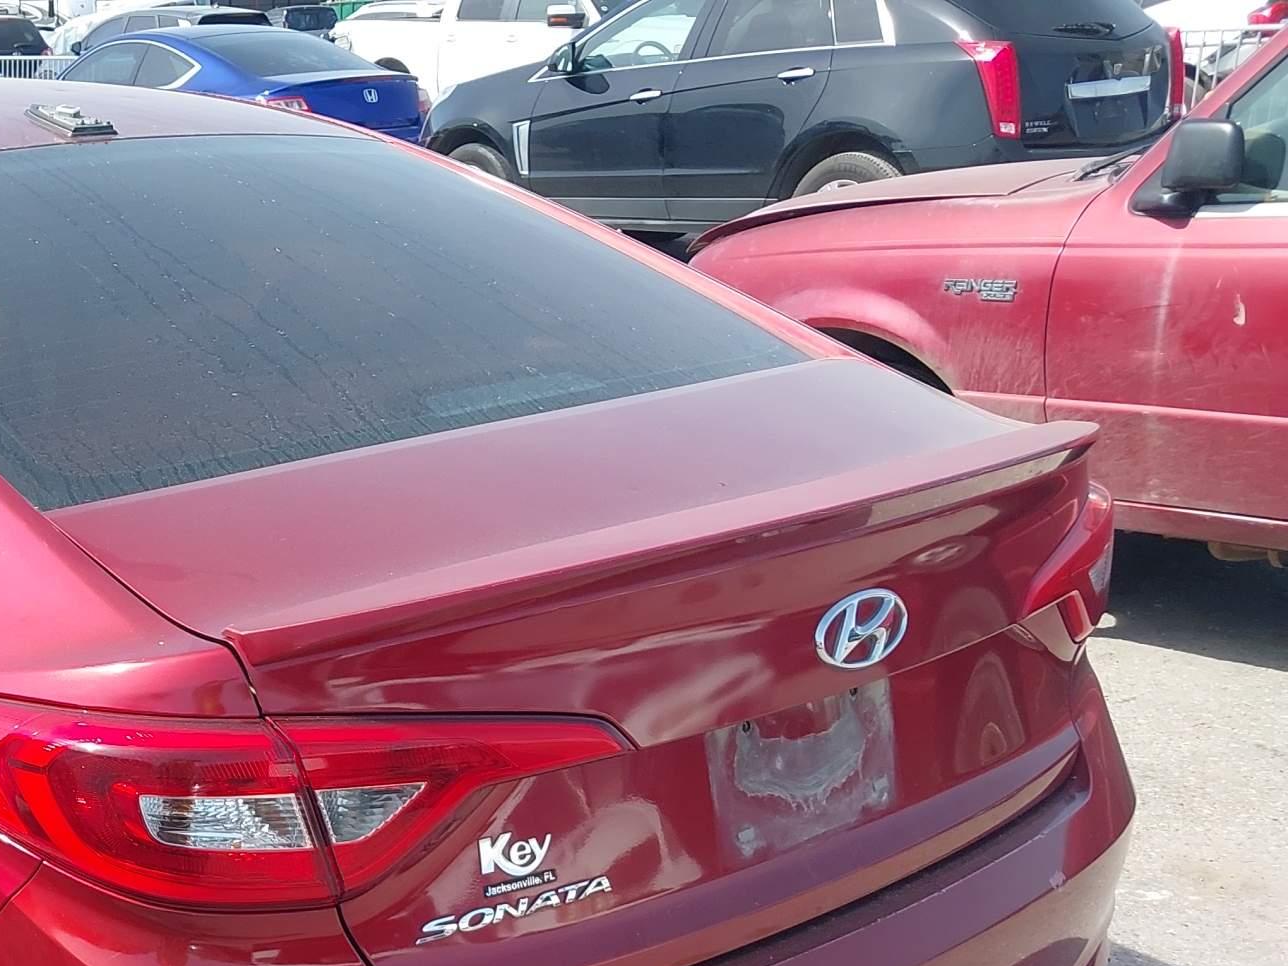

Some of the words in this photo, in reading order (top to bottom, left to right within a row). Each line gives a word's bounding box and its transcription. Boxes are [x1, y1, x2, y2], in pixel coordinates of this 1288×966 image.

[943, 278, 1017, 295] RANGER
[478, 832, 552, 877] Key
[544, 870, 556, 882] FL
[415, 875, 613, 945] SONATA
